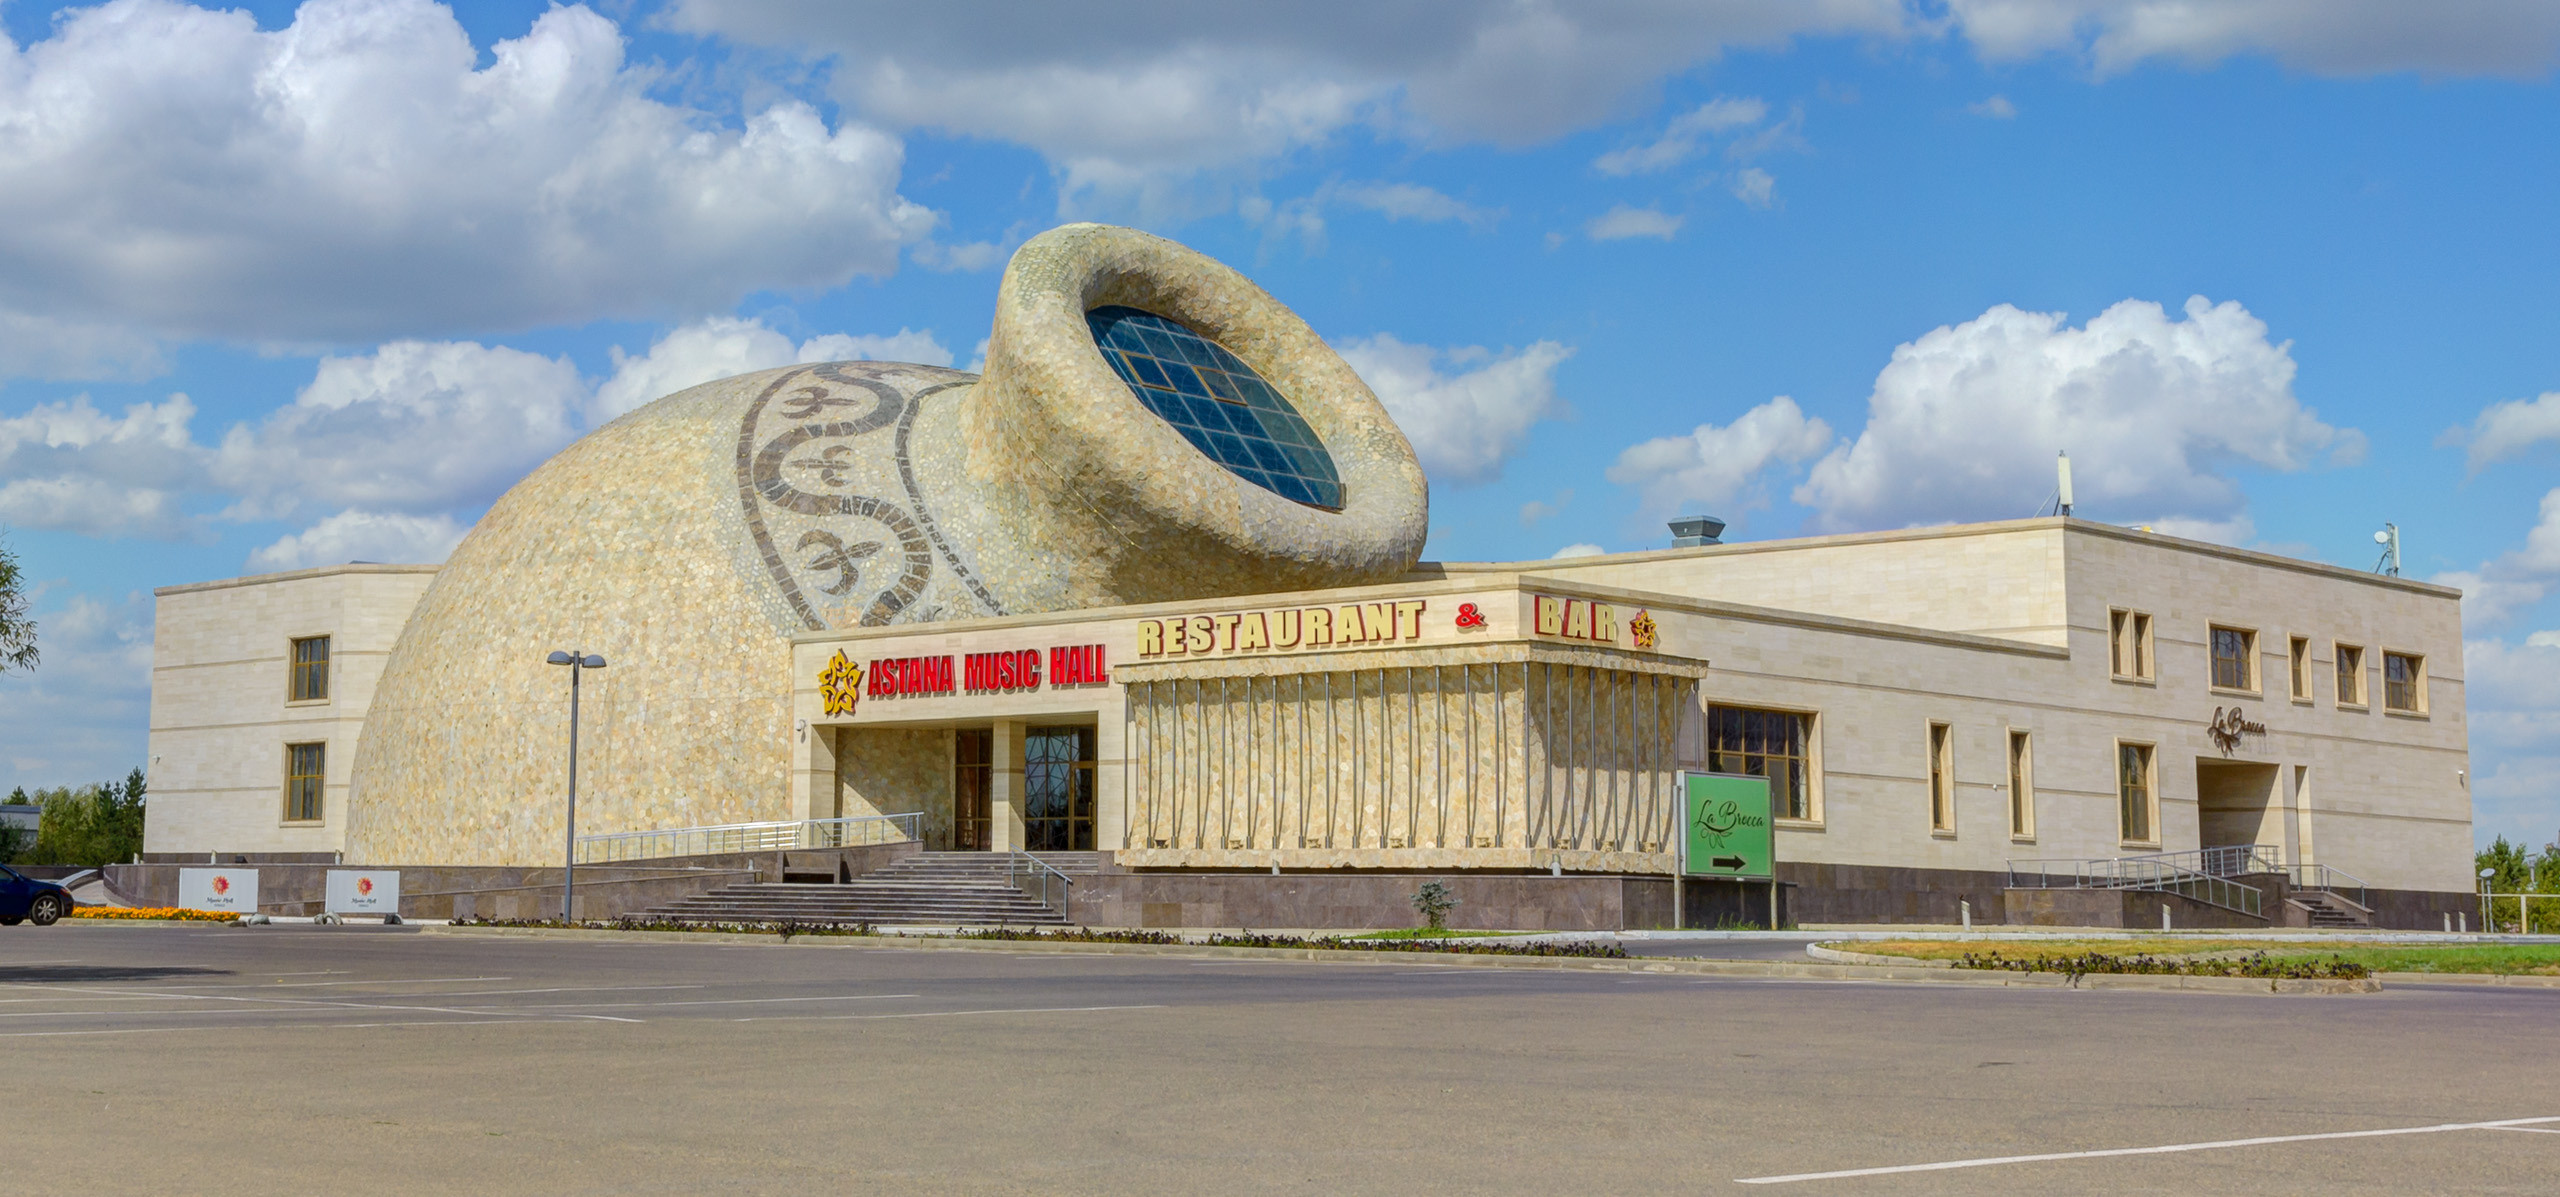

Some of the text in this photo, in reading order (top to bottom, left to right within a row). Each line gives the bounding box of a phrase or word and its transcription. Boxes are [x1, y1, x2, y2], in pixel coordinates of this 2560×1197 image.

[1137, 594, 1618, 657] RESTAURANT & BAR
[867, 643, 1110, 697] ASTANA MUSIC HALL
[1693, 799, 1715, 828] La
